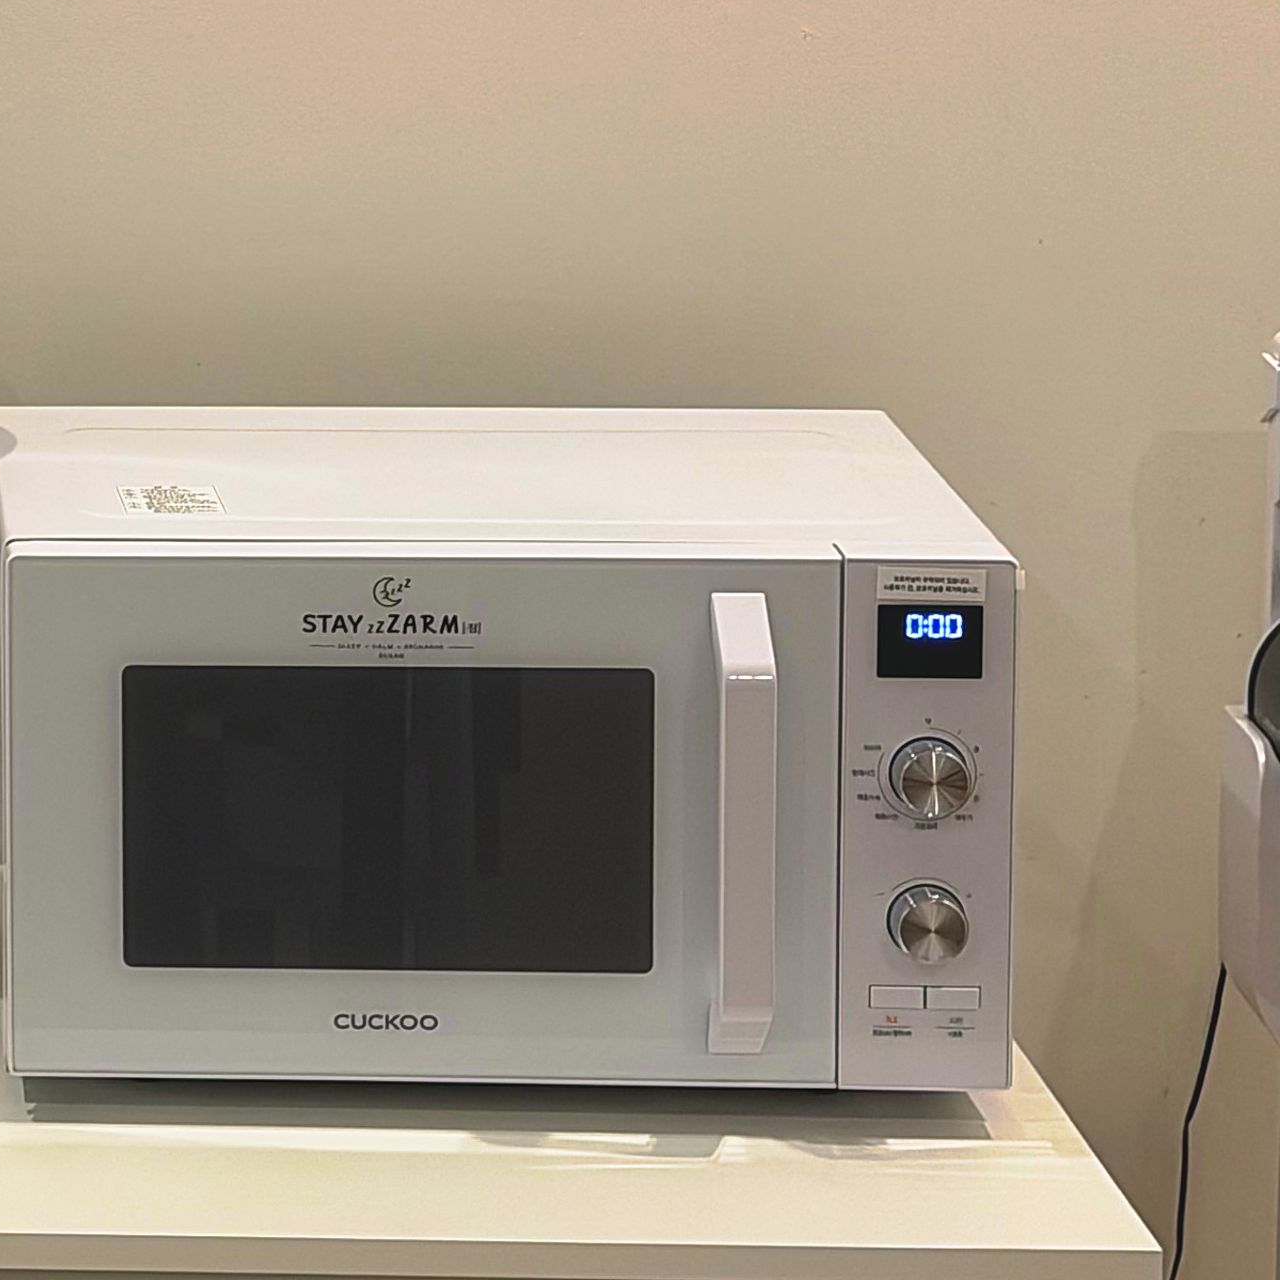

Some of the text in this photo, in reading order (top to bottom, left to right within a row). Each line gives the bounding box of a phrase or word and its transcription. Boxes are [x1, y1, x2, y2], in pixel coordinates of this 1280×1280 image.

[302, 614, 364, 634] STAY
[367, 613, 459, 634] zzZARM
[906, 614, 962, 638] 0:00
[333, 1014, 439, 1031] CUCKOO
